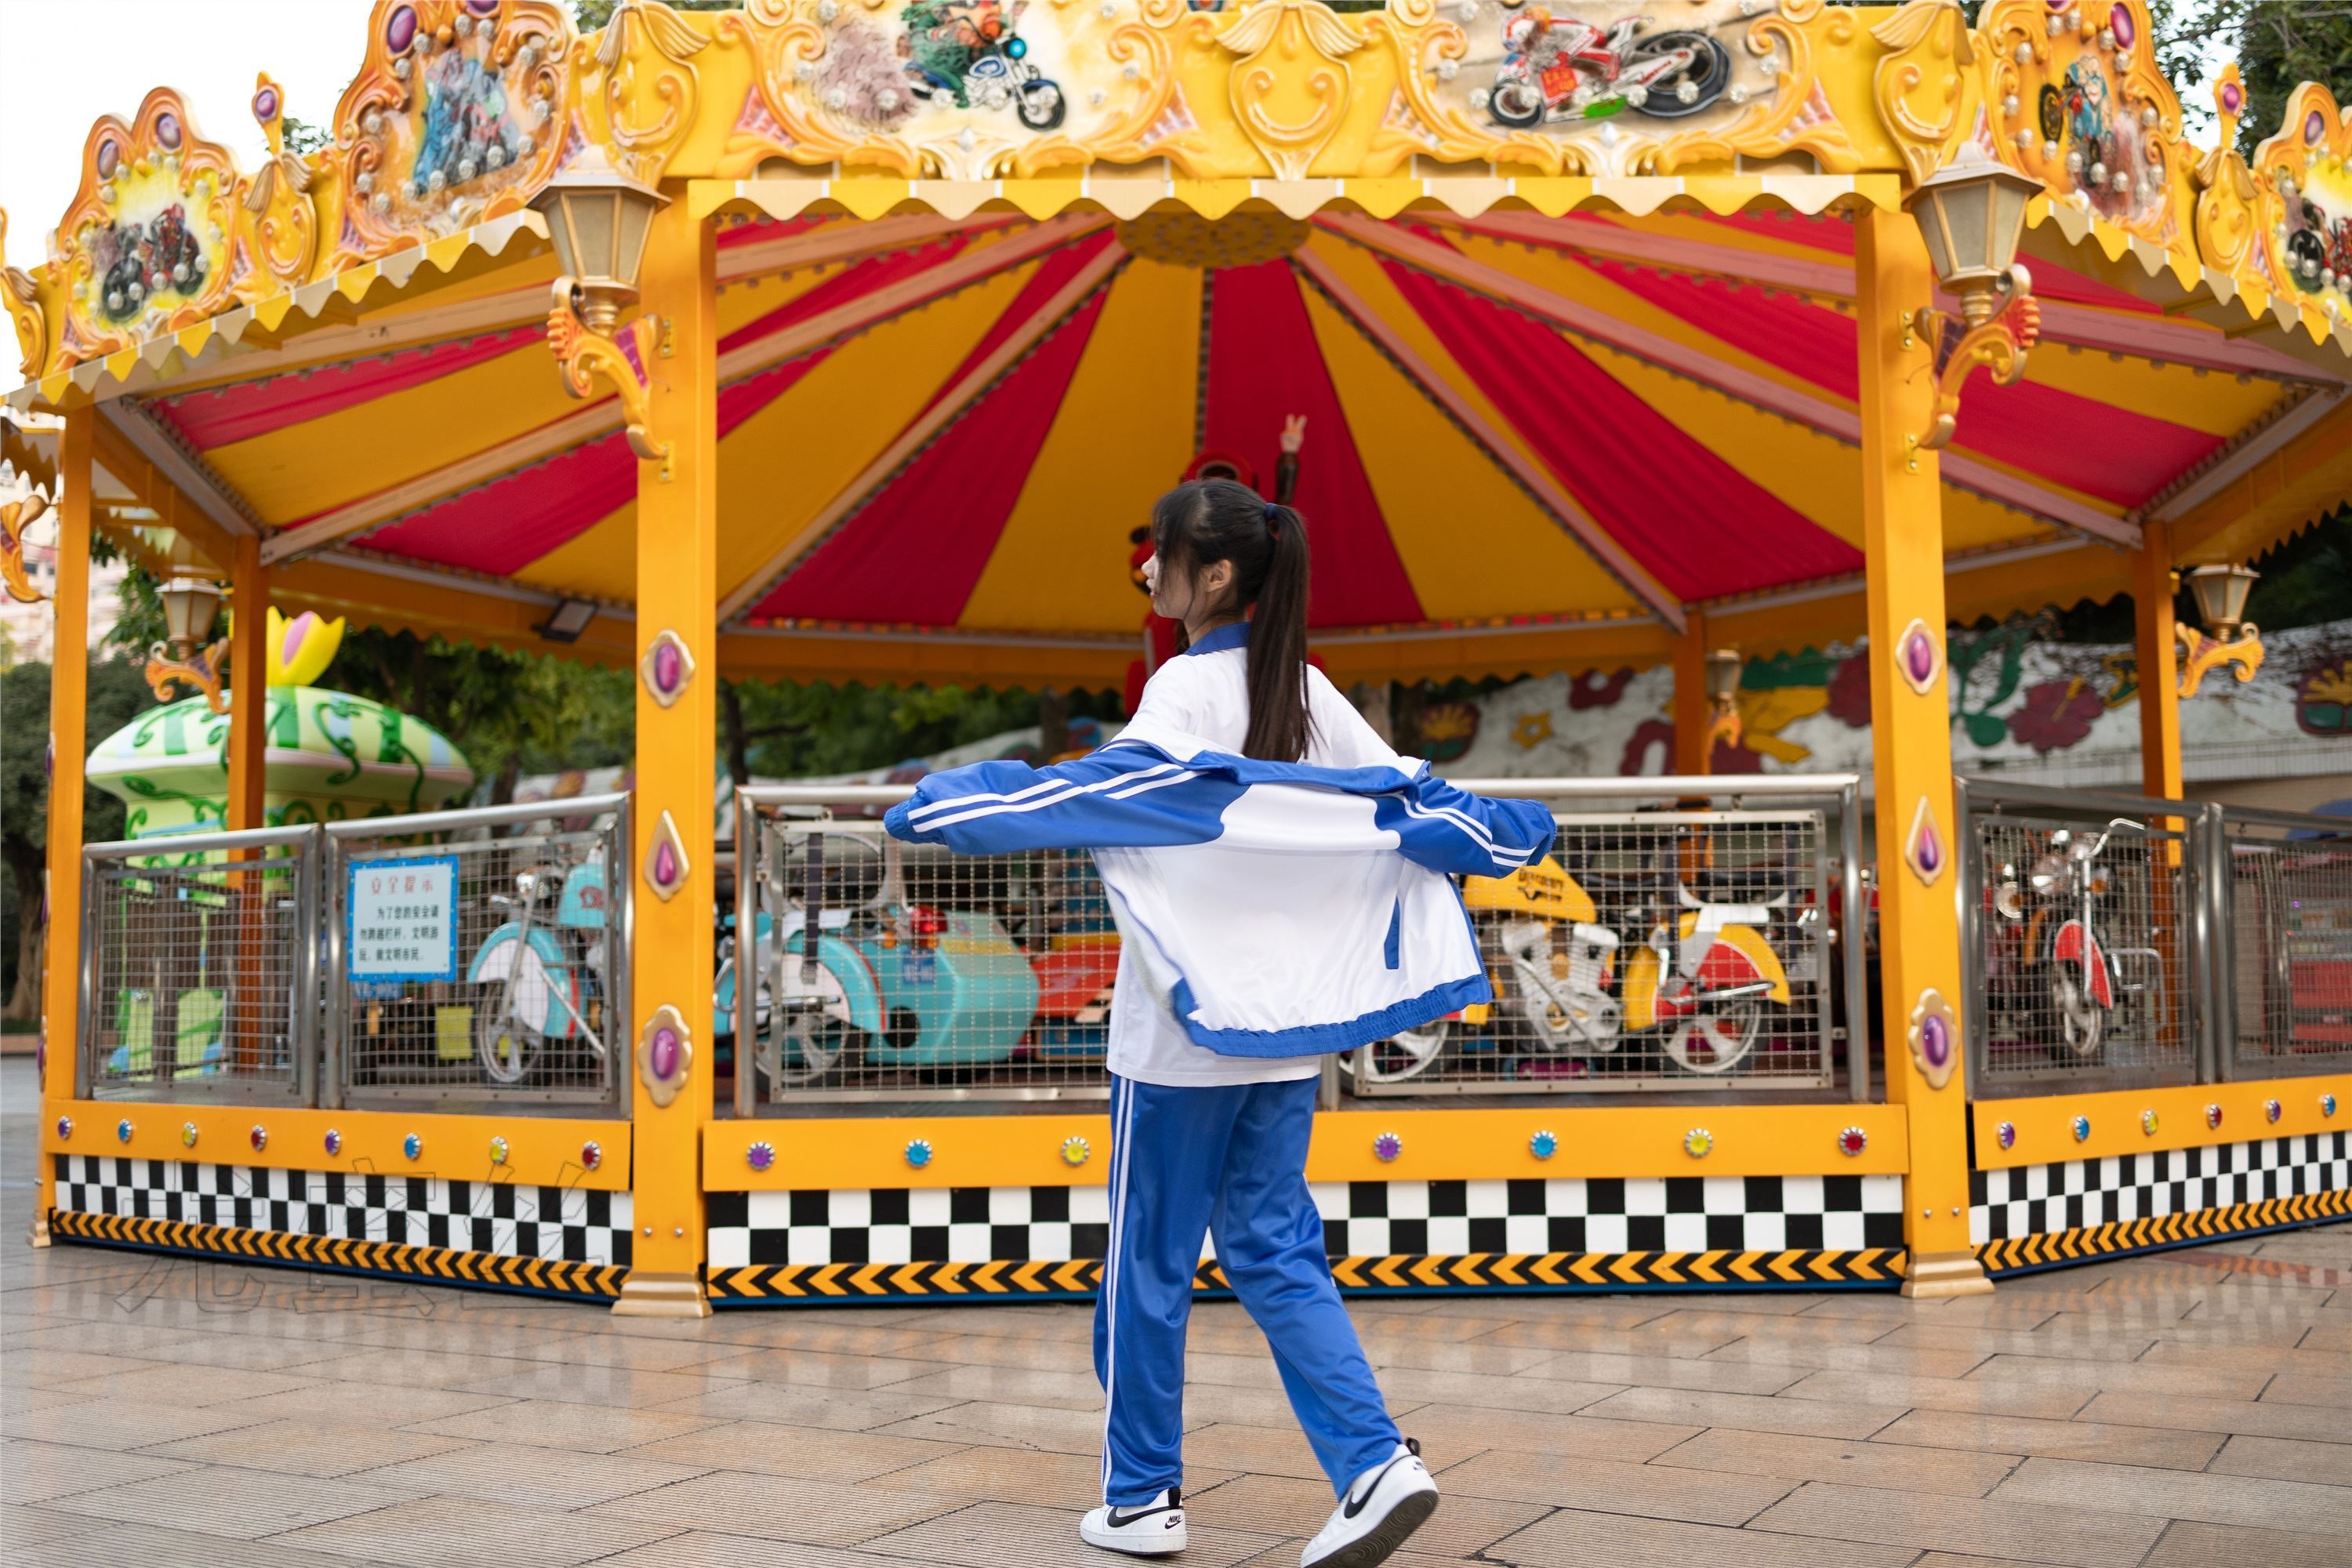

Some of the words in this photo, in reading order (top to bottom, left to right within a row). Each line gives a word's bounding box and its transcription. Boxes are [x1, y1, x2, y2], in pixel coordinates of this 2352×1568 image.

[371, 873, 433, 895] 安全提示
[377, 905, 439, 919] 为了您的安全请
